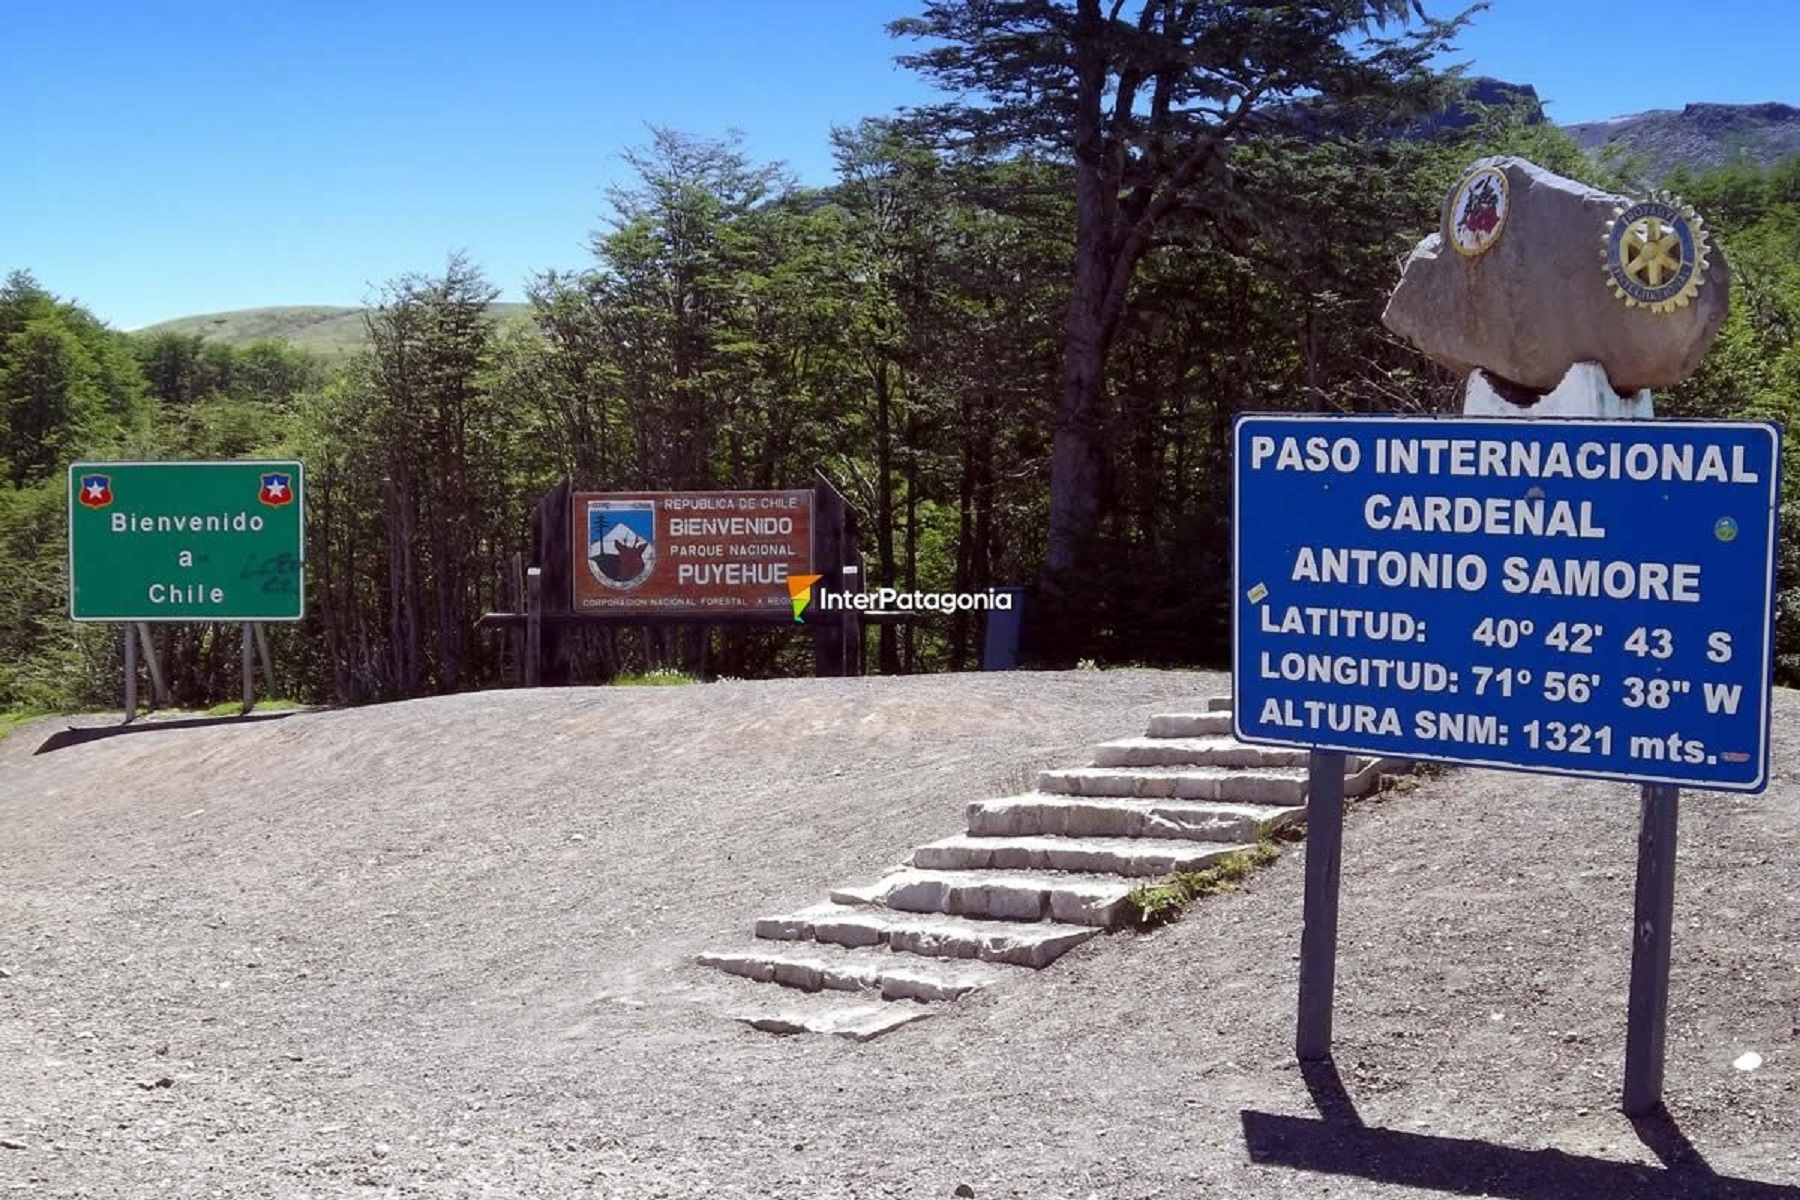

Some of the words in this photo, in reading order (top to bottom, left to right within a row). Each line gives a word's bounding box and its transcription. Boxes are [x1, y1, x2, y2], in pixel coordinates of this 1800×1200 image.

[1252, 436, 1361, 472] PASO
[1376, 439, 1759, 483] INTERNACIONAL
[664, 498, 735, 510] REPUBLICA
[739, 498, 757, 509] DE
[761, 497, 798, 509] CHILE
[111, 512, 263, 532] Bienvenido
[670, 517, 793, 536] BIENVENIDO
[1364, 494, 1606, 538] CARDENAL
[179, 550, 193, 567] a
[670, 544, 724, 557] PARQUE
[730, 544, 796, 556] NACIONAL
[678, 563, 788, 584] PUYEHUE
[1292, 547, 1487, 591] ANTONIO
[1502, 557, 1700, 602] SAMORE
[148, 584, 224, 603] Chile
[1261, 605, 1426, 642] LATITUD:
[1545, 622, 1603, 654] 42'
[1624, 627, 1674, 658] 43
[1707, 632, 1732, 663] S
[1261, 651, 1458, 693] LONGITUD:
[1544, 672, 1600, 703] 56'
[1704, 683, 1742, 715] W
[1260, 698, 1403, 736] ALTURA
[1415, 711, 1508, 746] SNM:
[1524, 720, 1612, 755] 1321
[1630, 732, 1717, 765] mts.
